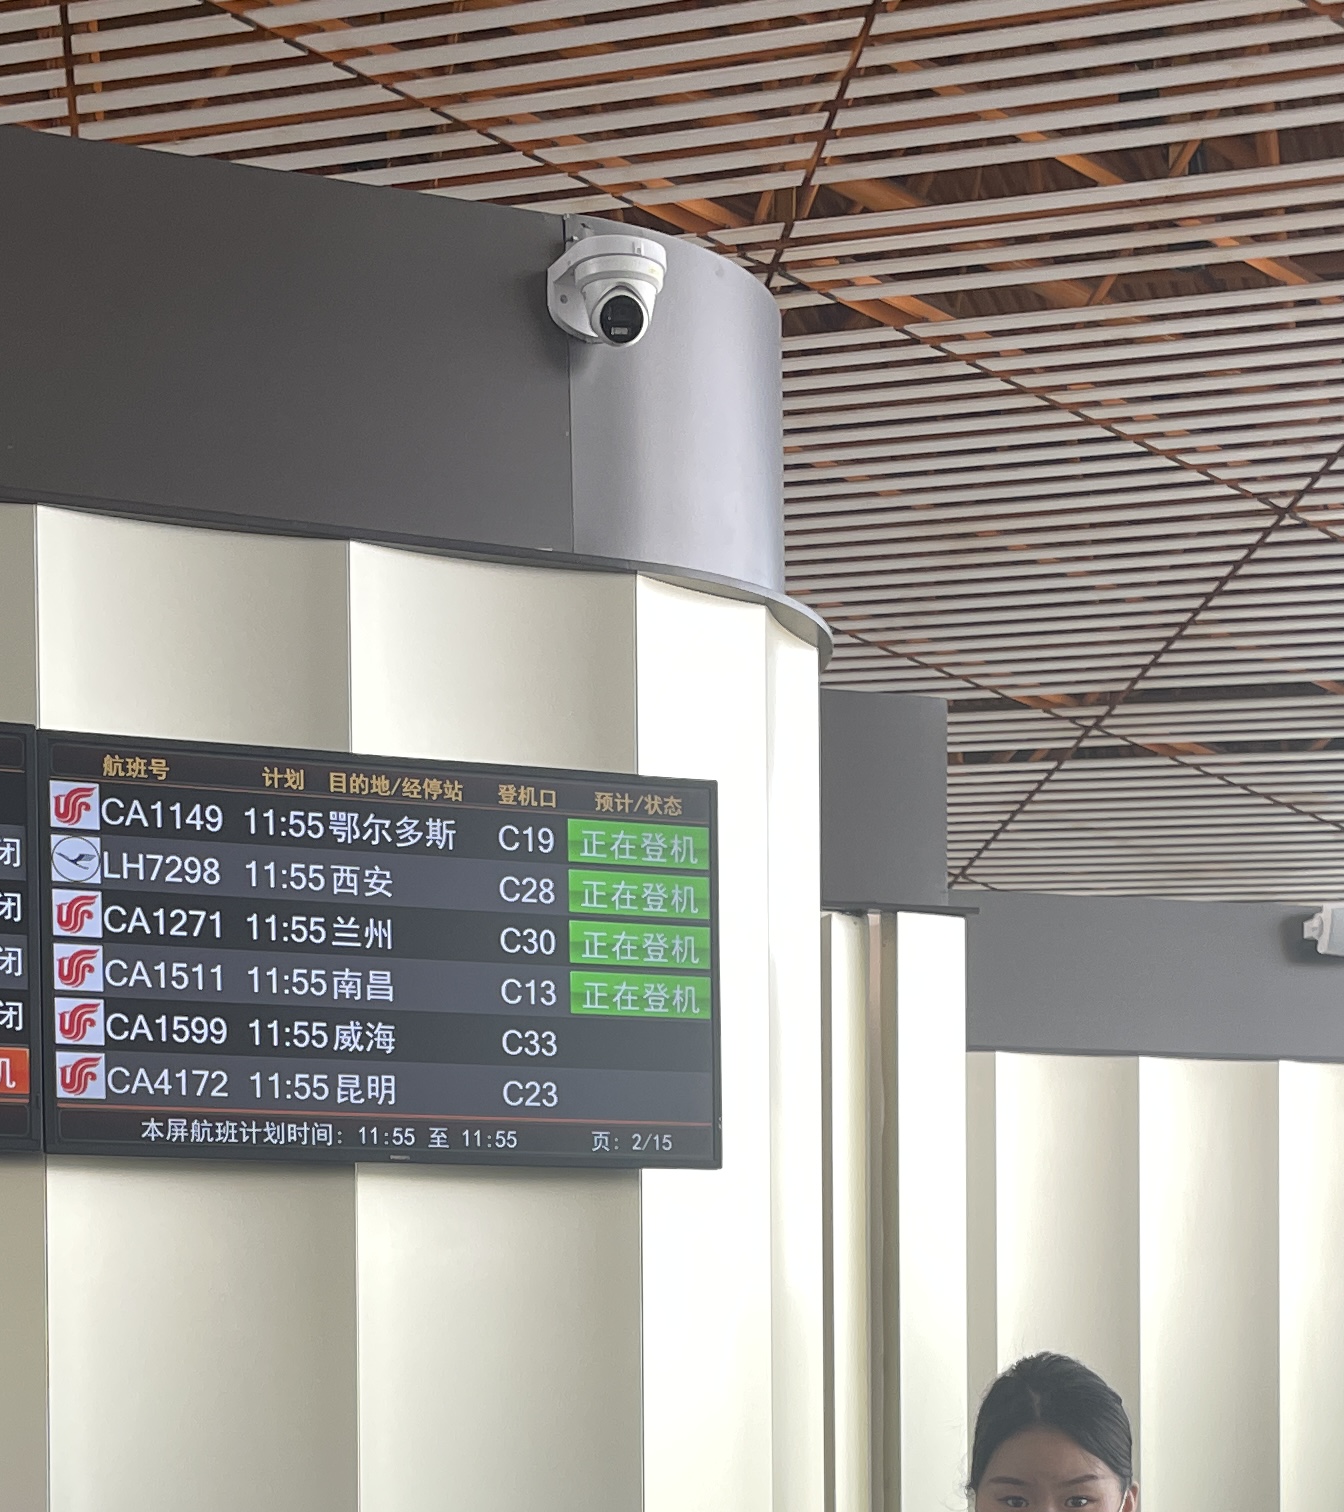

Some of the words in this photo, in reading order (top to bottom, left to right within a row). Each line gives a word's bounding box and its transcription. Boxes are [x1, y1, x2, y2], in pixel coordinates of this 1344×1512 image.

[103, 754, 169, 781] 航班号
[261, 766, 305, 791] 计划
[329, 772, 464, 802] 目的地/经停站
[497, 784, 557, 808] 登机口
[594, 791, 683, 817] 预计/状态
[101, 797, 223, 832] CA1149
[244, 807, 325, 839] 11:55
[328, 810, 457, 851] 鄂尔多斯
[498, 824, 555, 854] C19
[579, 829, 699, 865] 正在登机
[103, 851, 221, 885] LH7298
[245, 860, 326, 891] 11:55
[330, 864, 393, 898] 西安
[499, 876, 555, 905] C28
[580, 880, 699, 914] 正在登机
[103, 905, 221, 938] CA1271
[246, 913, 327, 944] 11:55
[331, 915, 393, 950] 兰州
[500, 927, 556, 955] C30
[581, 930, 700, 964] 正在登机
[104, 959, 222, 991] CA1511
[247, 966, 328, 996] 11:55
[332, 967, 394, 1002] 南昌
[501, 978, 557, 1006] C13
[582, 980, 701, 1014] 正在登机
[106, 1012, 228, 1045] CA1599
[248, 1019, 329, 1049] 11:55
[333, 1020, 396, 1055] 威海
[502, 1029, 558, 1057] C33
[107, 1066, 229, 1097] CA4172
[249, 1071, 329, 1101] 11:55
[336, 1074, 396, 1105] 昆明
[502, 1080, 558, 1107] C23
[358, 1126, 416, 1146] 11:55
[427, 1127, 450, 1149] 至
[462, 1129, 518, 1149] 11:55
[631, 1133, 673, 1151] 2/15
